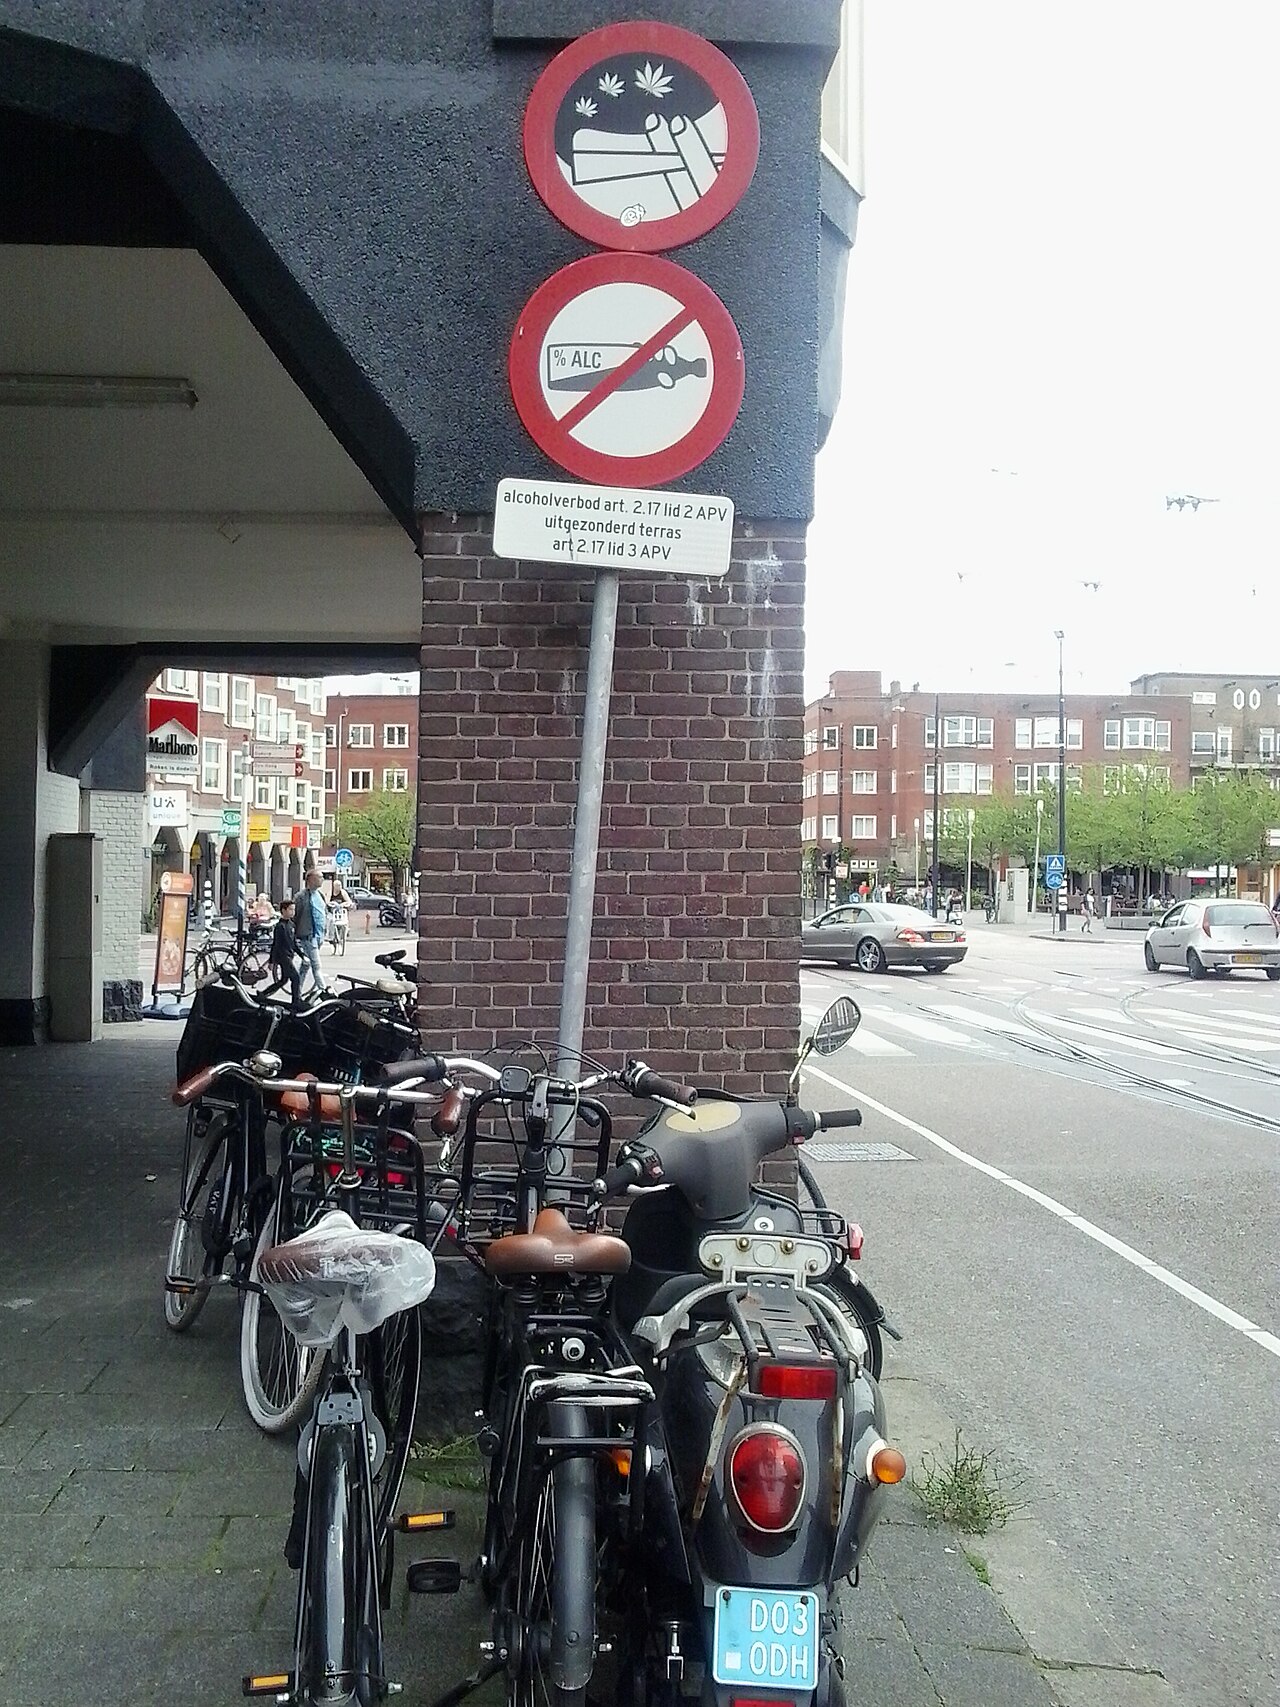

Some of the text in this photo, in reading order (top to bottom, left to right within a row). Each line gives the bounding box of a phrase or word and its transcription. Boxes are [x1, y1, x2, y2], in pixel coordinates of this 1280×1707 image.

[553, 349, 602, 369] % ALC
[503, 489, 728, 522] alcoholverbod art. 2.17 lid 2 APV
[545, 514, 682, 540] uitgezonderd terras
[552, 538, 672, 561] art 2.17 lid 3 APV
[148, 733, 198, 756] Marlboro
[750, 1598, 809, 1637] D03
